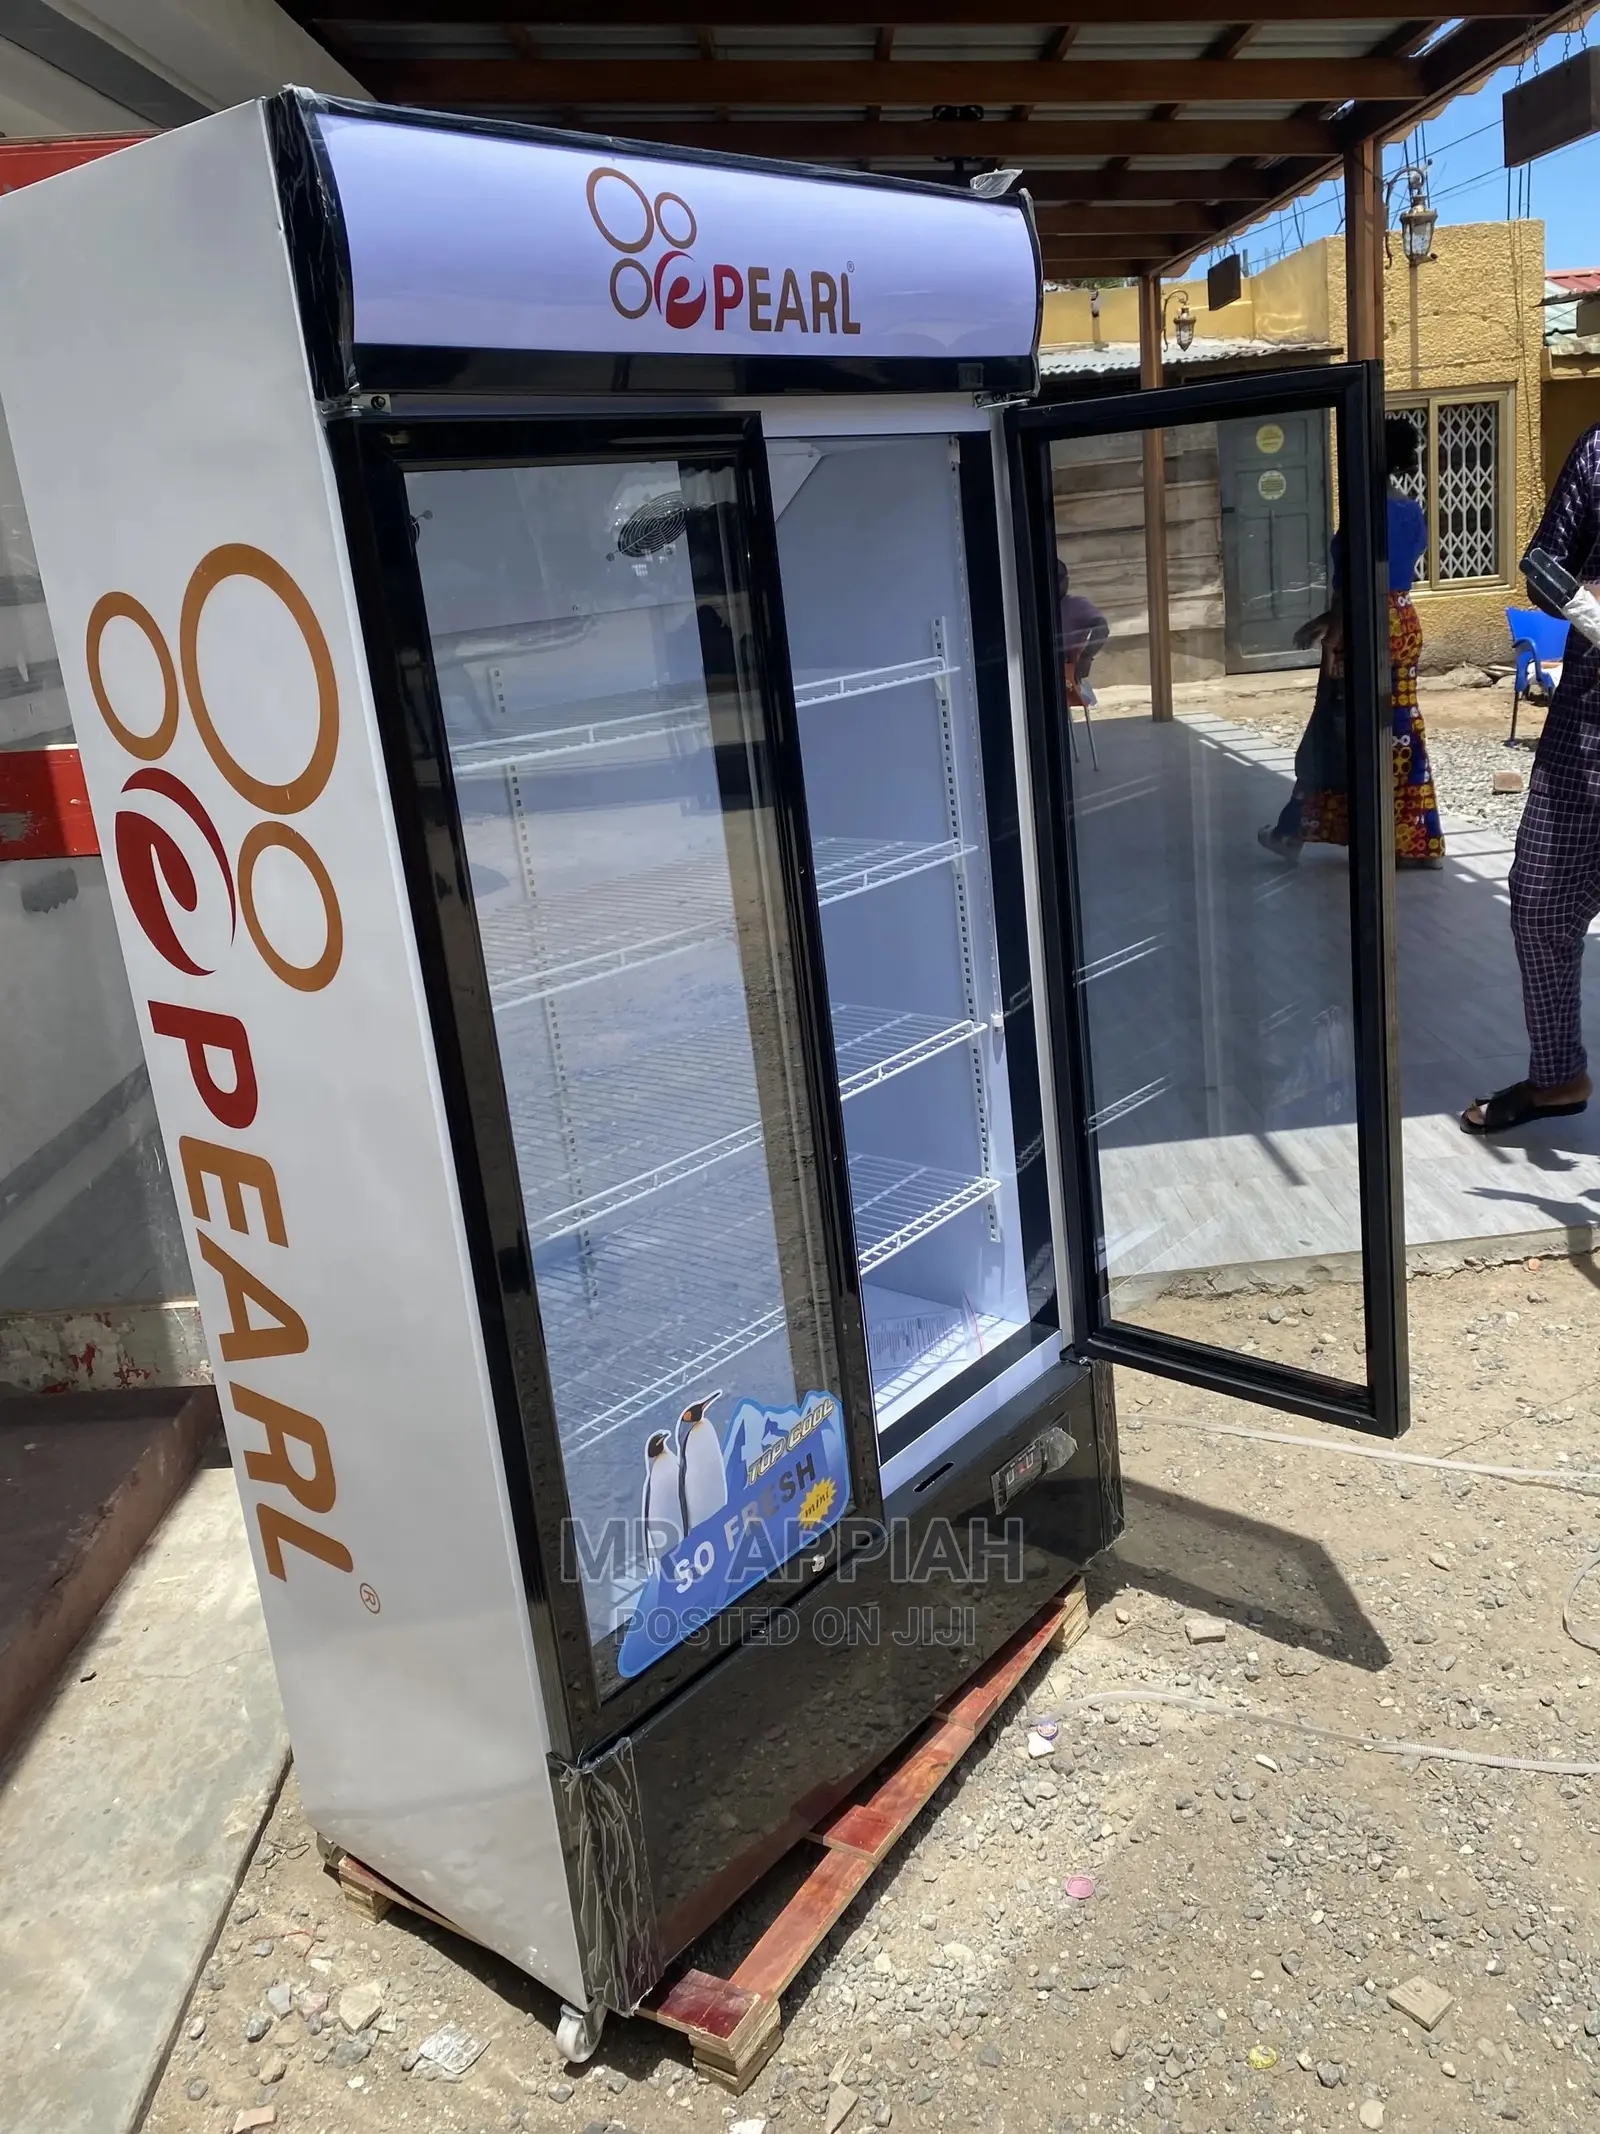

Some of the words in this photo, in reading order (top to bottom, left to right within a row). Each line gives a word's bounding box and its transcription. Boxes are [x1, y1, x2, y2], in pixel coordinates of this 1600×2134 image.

[713, 263, 861, 335] PEARL
[147, 999, 354, 1584] PEARL
[748, 1436, 785, 1485] TOP
[786, 1398, 835, 1453] COOL
[675, 1540, 715, 1594] SO
[723, 1452, 816, 1552] FRESH
[804, 1486, 830, 1518] mini
